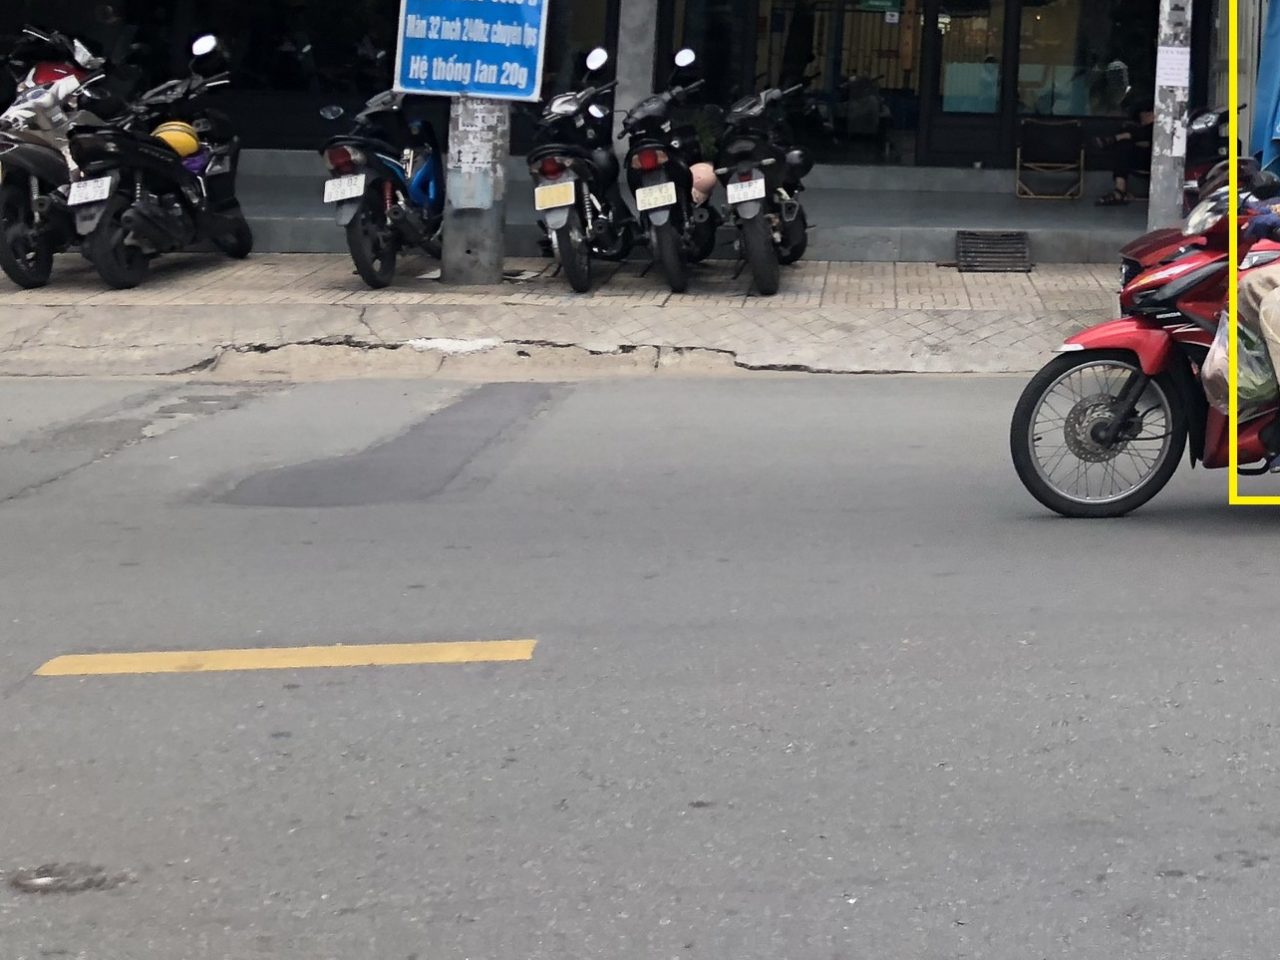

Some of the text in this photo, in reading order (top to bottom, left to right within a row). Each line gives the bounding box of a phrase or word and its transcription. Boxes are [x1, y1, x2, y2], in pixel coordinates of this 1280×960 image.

[409, 53, 529, 90] Hệ thống lan 20g
